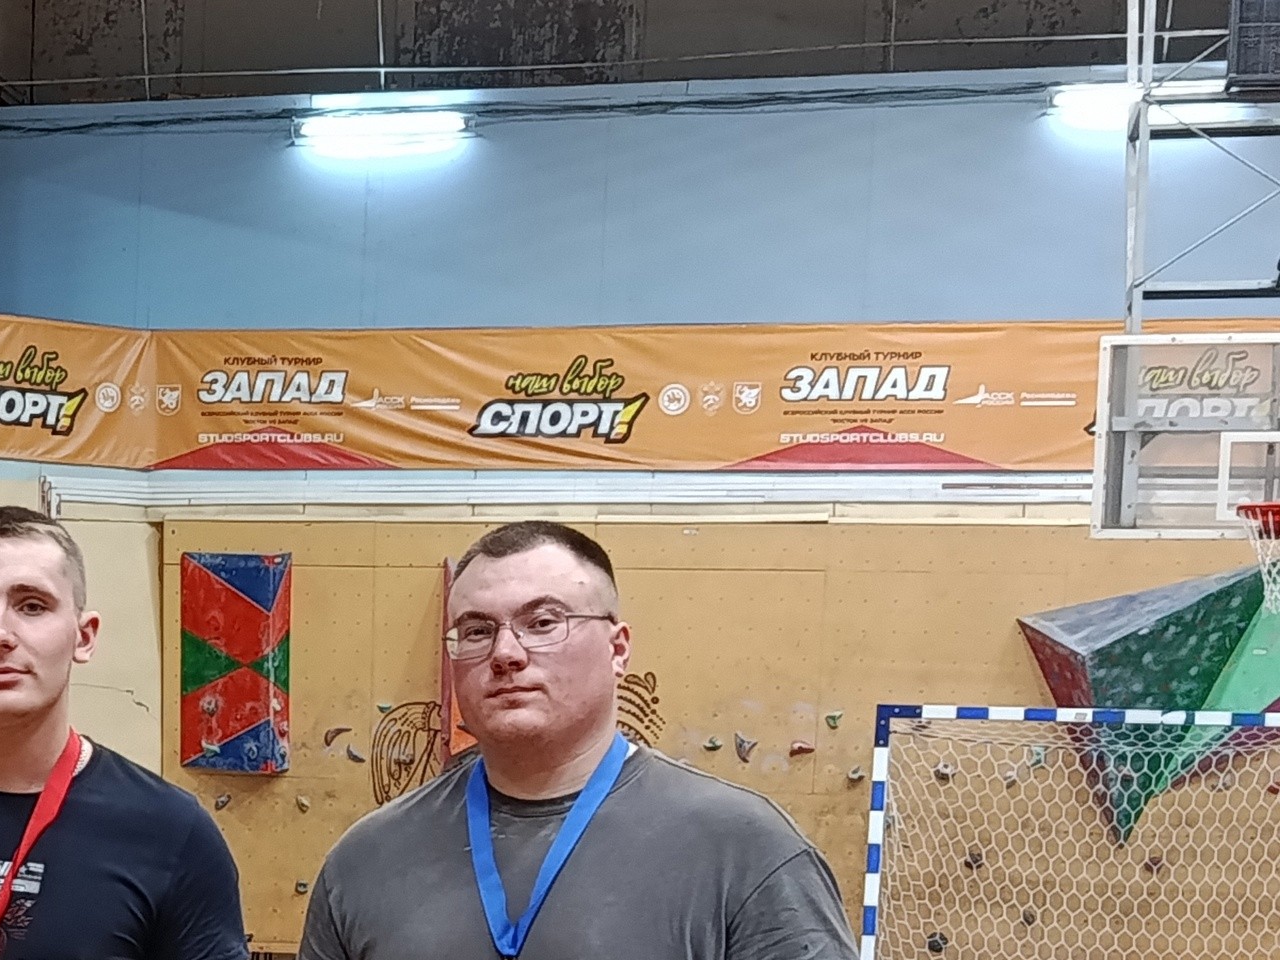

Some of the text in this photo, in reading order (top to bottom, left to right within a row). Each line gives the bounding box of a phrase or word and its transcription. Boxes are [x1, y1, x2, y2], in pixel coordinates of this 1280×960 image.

[14, 345, 68, 388] выбор
[224, 355, 323, 366] КЛУБНЫЙ ТУРНИР
[810, 350, 922, 361] КЛУБНЫЙ ТУРНИР
[1188, 347, 1261, 394] выбор
[197, 369, 349, 404] ЗАПАД
[506, 355, 625, 399] наш выбор
[780, 365, 950, 402] ЗАПАД
[470, 394, 650, 442] СПОРТ!
[198, 433, 344, 444] STUDSPORTCLUBS.RU
[779, 433, 945, 443] STUDSPORTCLUBS.RU
